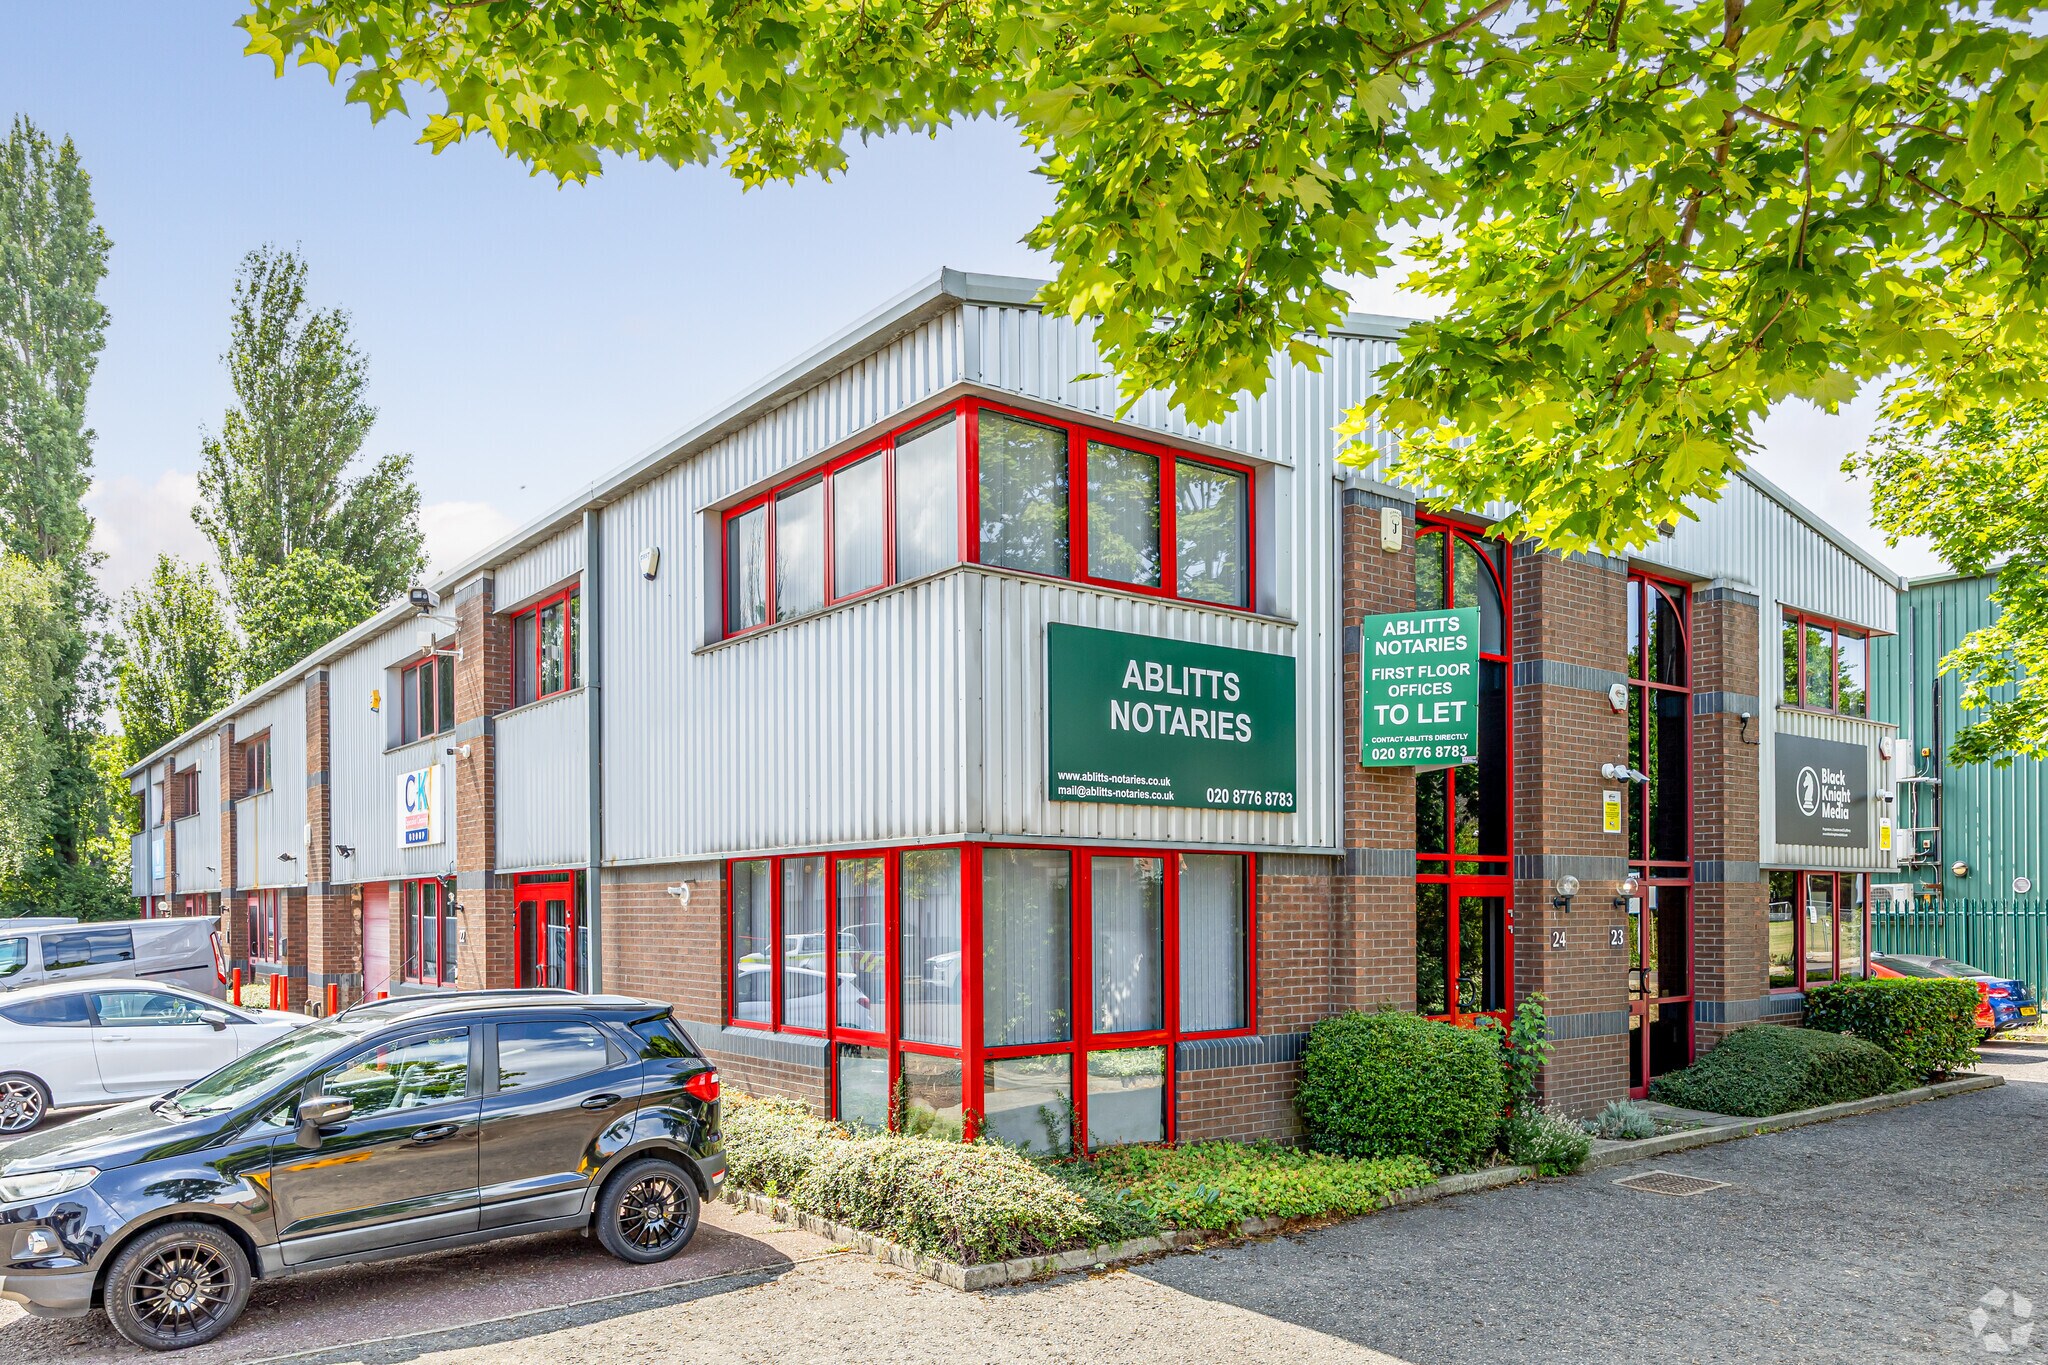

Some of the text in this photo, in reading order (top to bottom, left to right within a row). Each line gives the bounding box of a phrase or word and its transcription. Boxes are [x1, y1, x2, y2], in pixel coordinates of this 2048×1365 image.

[1383, 617, 1460, 636] ABLITTS
[1375, 635, 1468, 656] NOTARIES
[1121, 659, 1241, 702] ABLITTS
[1372, 663, 1471, 681] FIRST FLOOR
[1388, 682, 1453, 697] OFFICES
[1110, 699, 1252, 742] NOTARIES
[1373, 701, 1467, 726] TO LET
[1372, 733, 1468, 744] CONTACT ABLITTS DIRECTLY
[1372, 745, 1468, 760] 020 8776 8783
[1058, 771, 1171, 787] www.ablitts-notaries.co.uk
[1822, 768, 1846, 785] Black
[1058, 785, 1175, 801] mail@ablitts-notaries.co.uk
[1206, 787, 1294, 807] 020 8776 8783
[1822, 785, 1851, 806] Knight
[1822, 803, 1849, 820] Media
[1552, 931, 1567, 948] 24
[1610, 929, 1624, 945] 23
